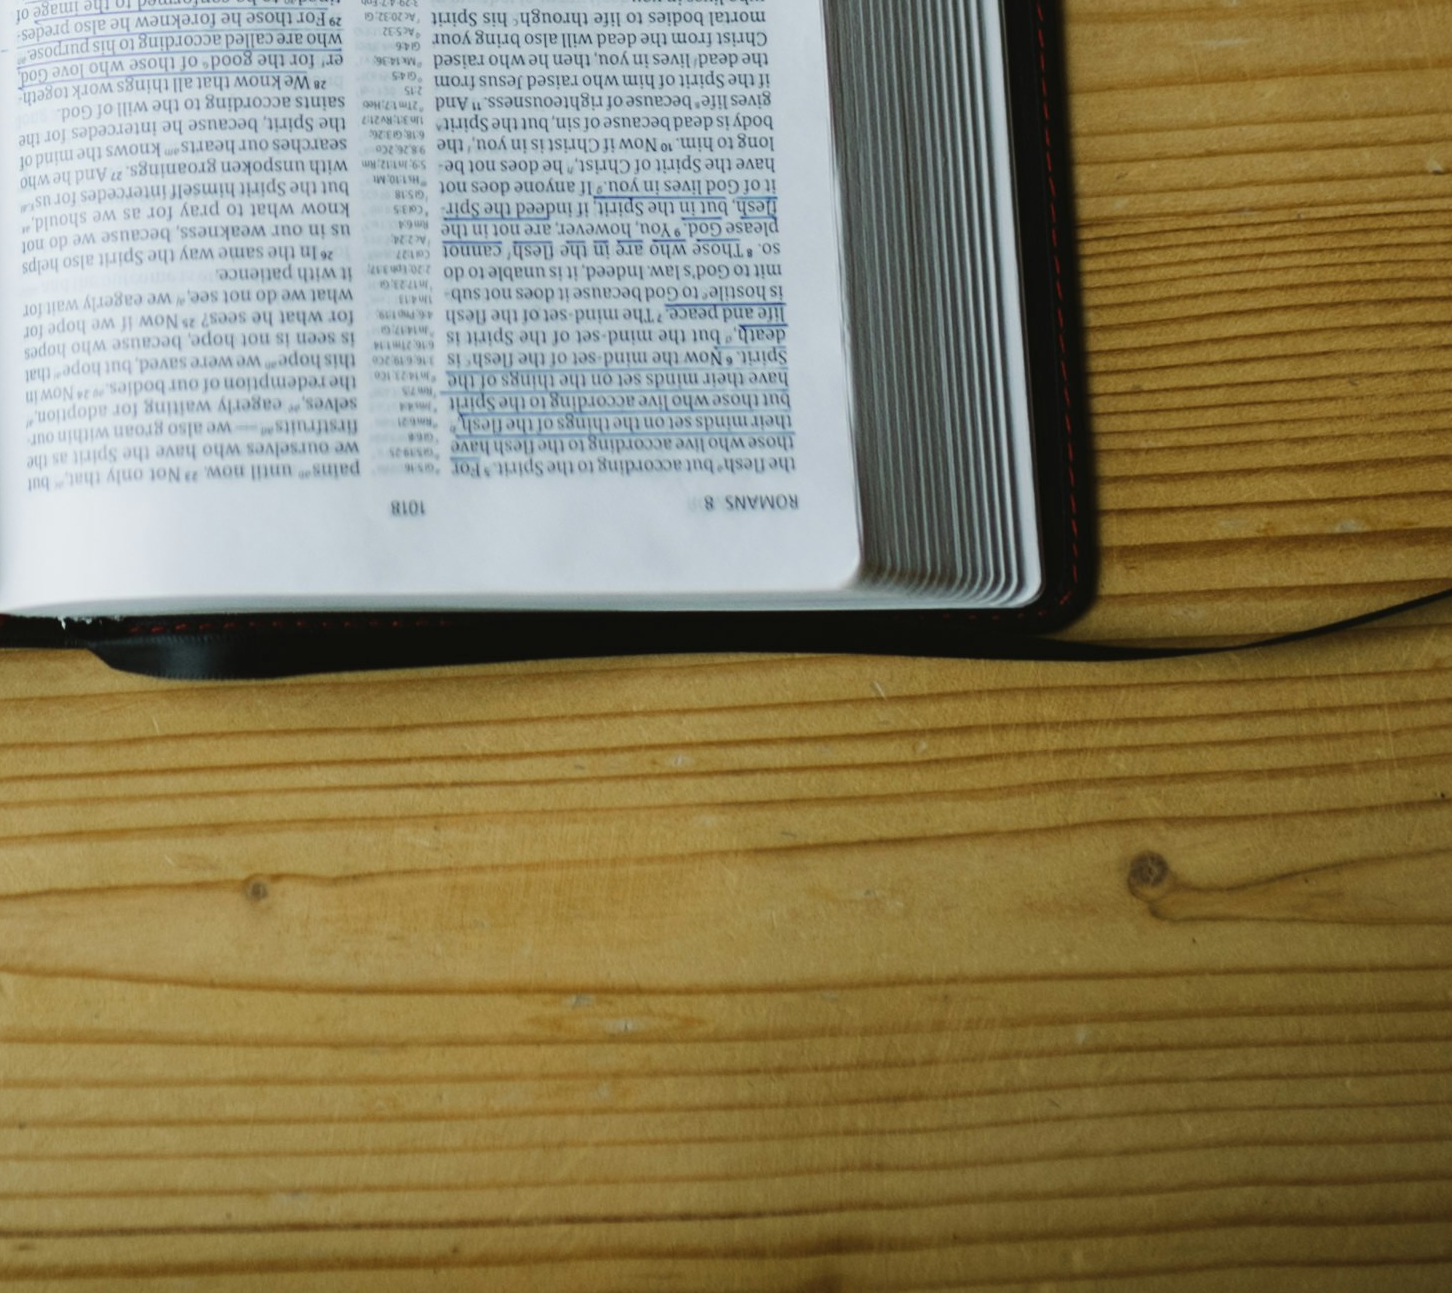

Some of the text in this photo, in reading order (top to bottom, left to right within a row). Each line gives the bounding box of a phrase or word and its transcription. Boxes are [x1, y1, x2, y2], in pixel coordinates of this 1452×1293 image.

[58, 96, 346, 123] saints according to the will of God.
[216, 264, 353, 284] it with patience.
[443, 264, 783, 283] mit to God's law. Indeed, it is unable to do
[391, 500, 426, 517] 1018
[704, 494, 799, 512] ROMANS 8
